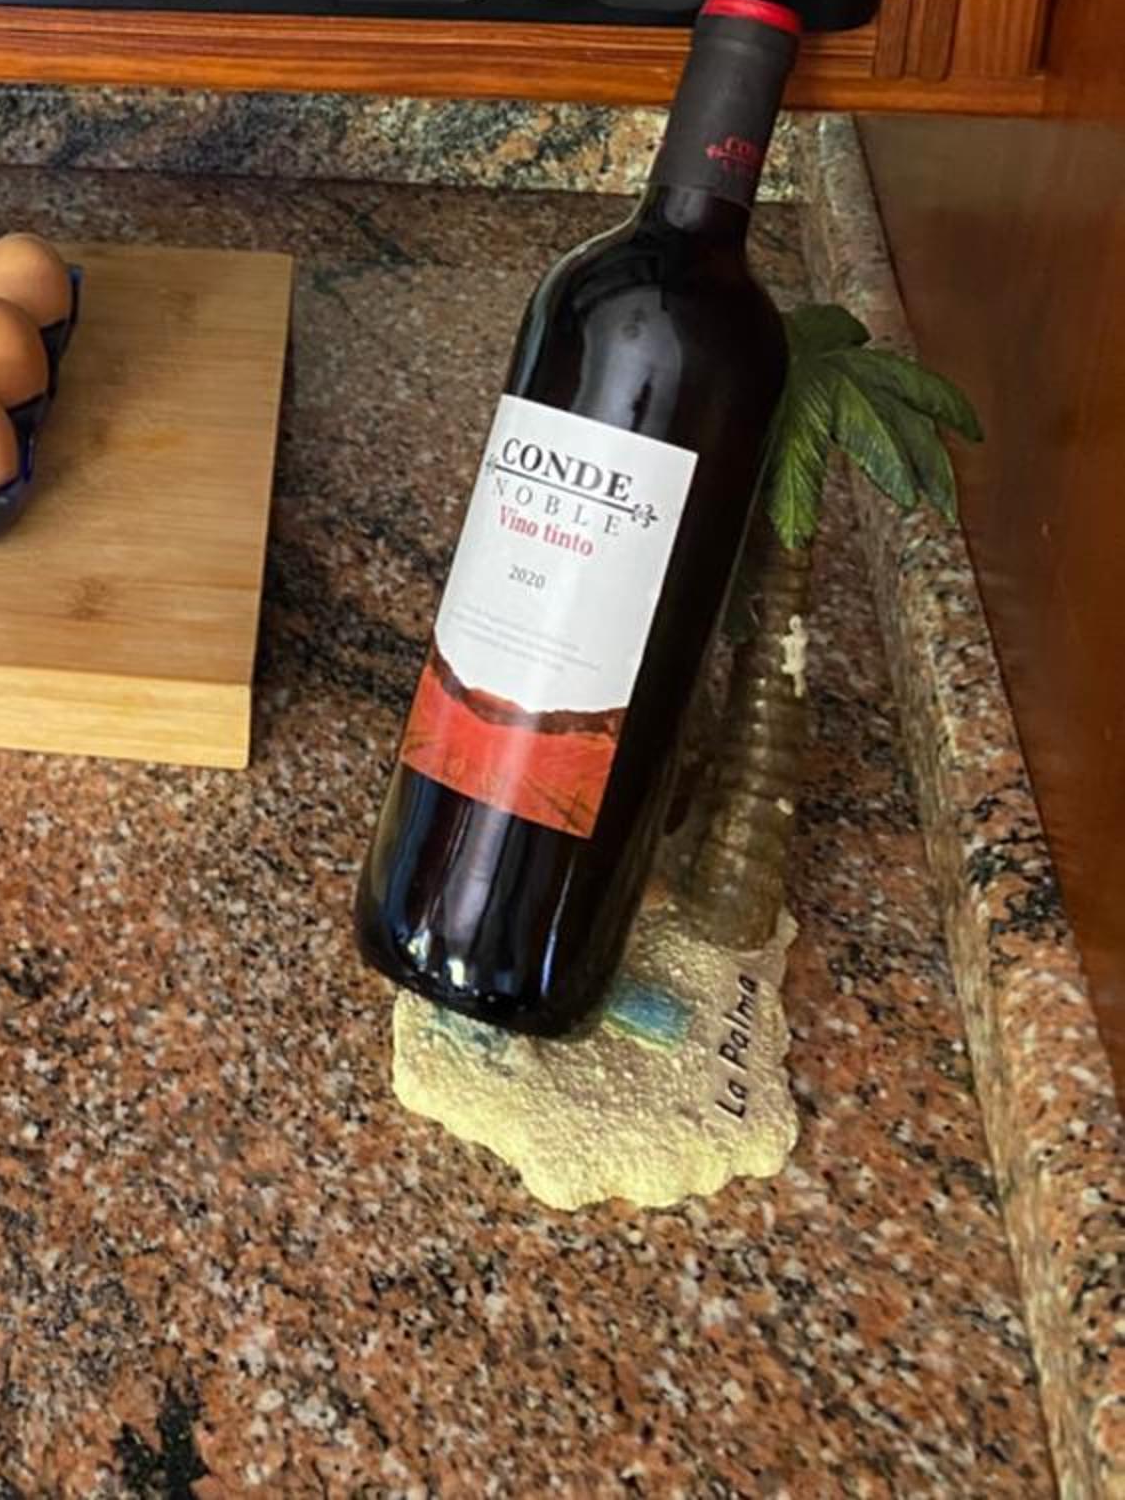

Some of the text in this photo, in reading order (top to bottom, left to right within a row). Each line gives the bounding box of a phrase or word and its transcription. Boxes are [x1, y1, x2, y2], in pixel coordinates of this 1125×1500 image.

[502, 438, 634, 501] CONDE
[492, 477, 621, 536] NOBLE
[498, 505, 593, 557] Vino tinto
[509, 565, 546, 590] 2020
[715, 974, 757, 1118] La Palma
